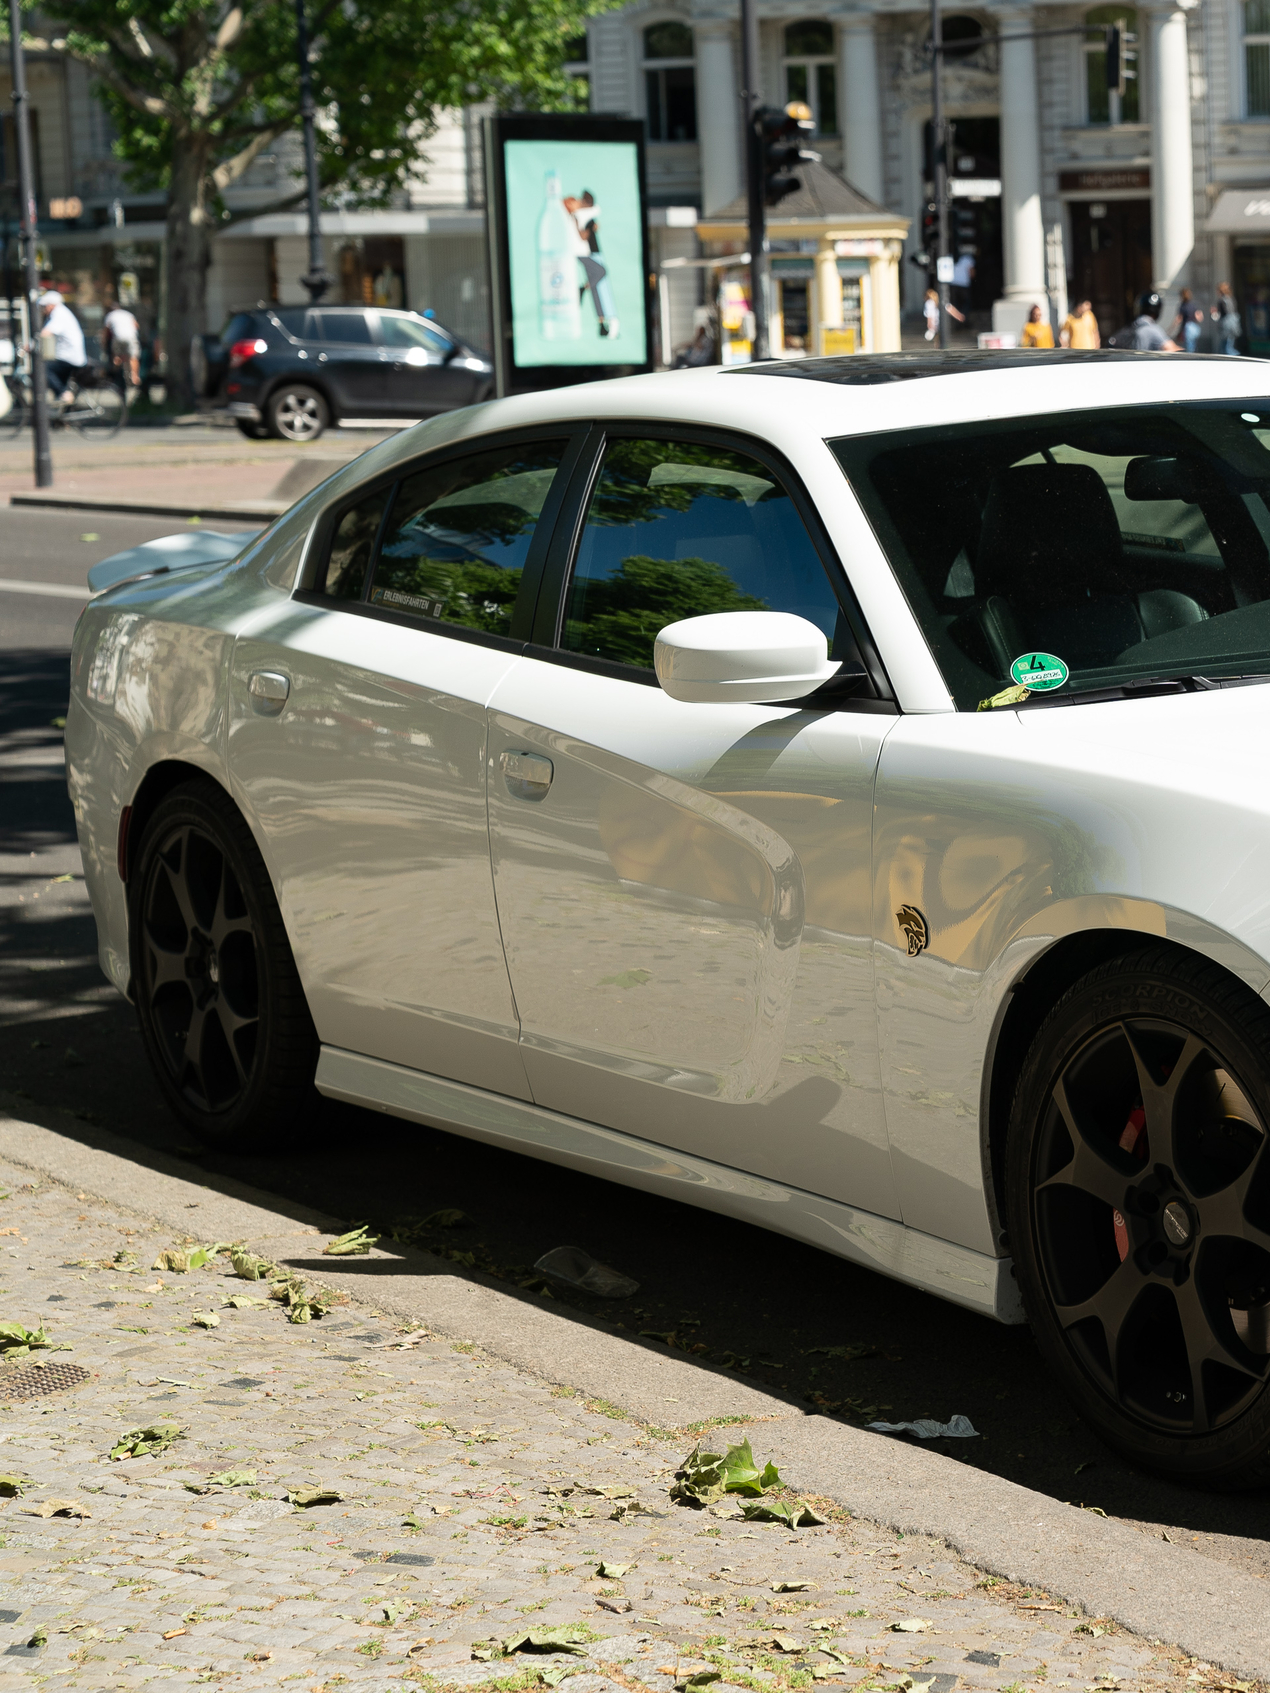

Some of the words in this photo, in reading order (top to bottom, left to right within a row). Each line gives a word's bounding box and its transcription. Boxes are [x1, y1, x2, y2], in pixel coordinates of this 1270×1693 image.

[383, 590, 430, 610] ERLEBNISFAHRTEN
[1030, 655, 1046, 671] 4
[1091, 984, 1209, 1020] SCORPION
[1091, 1001, 1122, 1024] ICE
[1129, 999, 1140, 1011] &
[1150, 1001, 1213, 1036] SNOW
